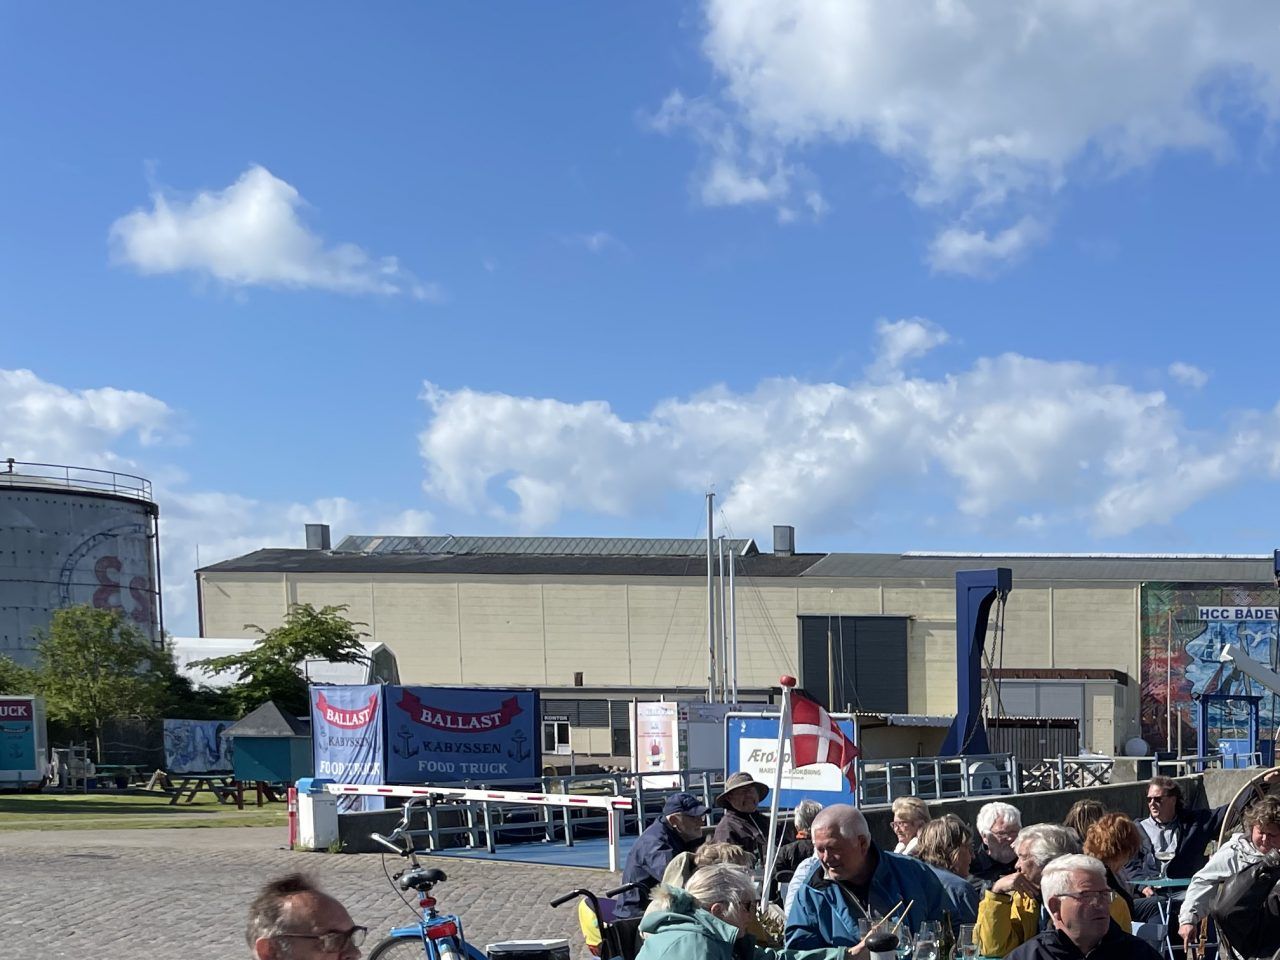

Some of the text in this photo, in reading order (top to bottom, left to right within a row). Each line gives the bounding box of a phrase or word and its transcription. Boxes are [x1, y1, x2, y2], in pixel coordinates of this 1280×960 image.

[1200, 608, 1229, 619] HCC
[0, 706, 28, 717] UCK
[326, 709, 370, 726] BALLAST
[420, 709, 502, 729] BALLAST
[422, 741, 502, 754] KABYSSEN
[418, 760, 508, 774] FOOD TRUCK
